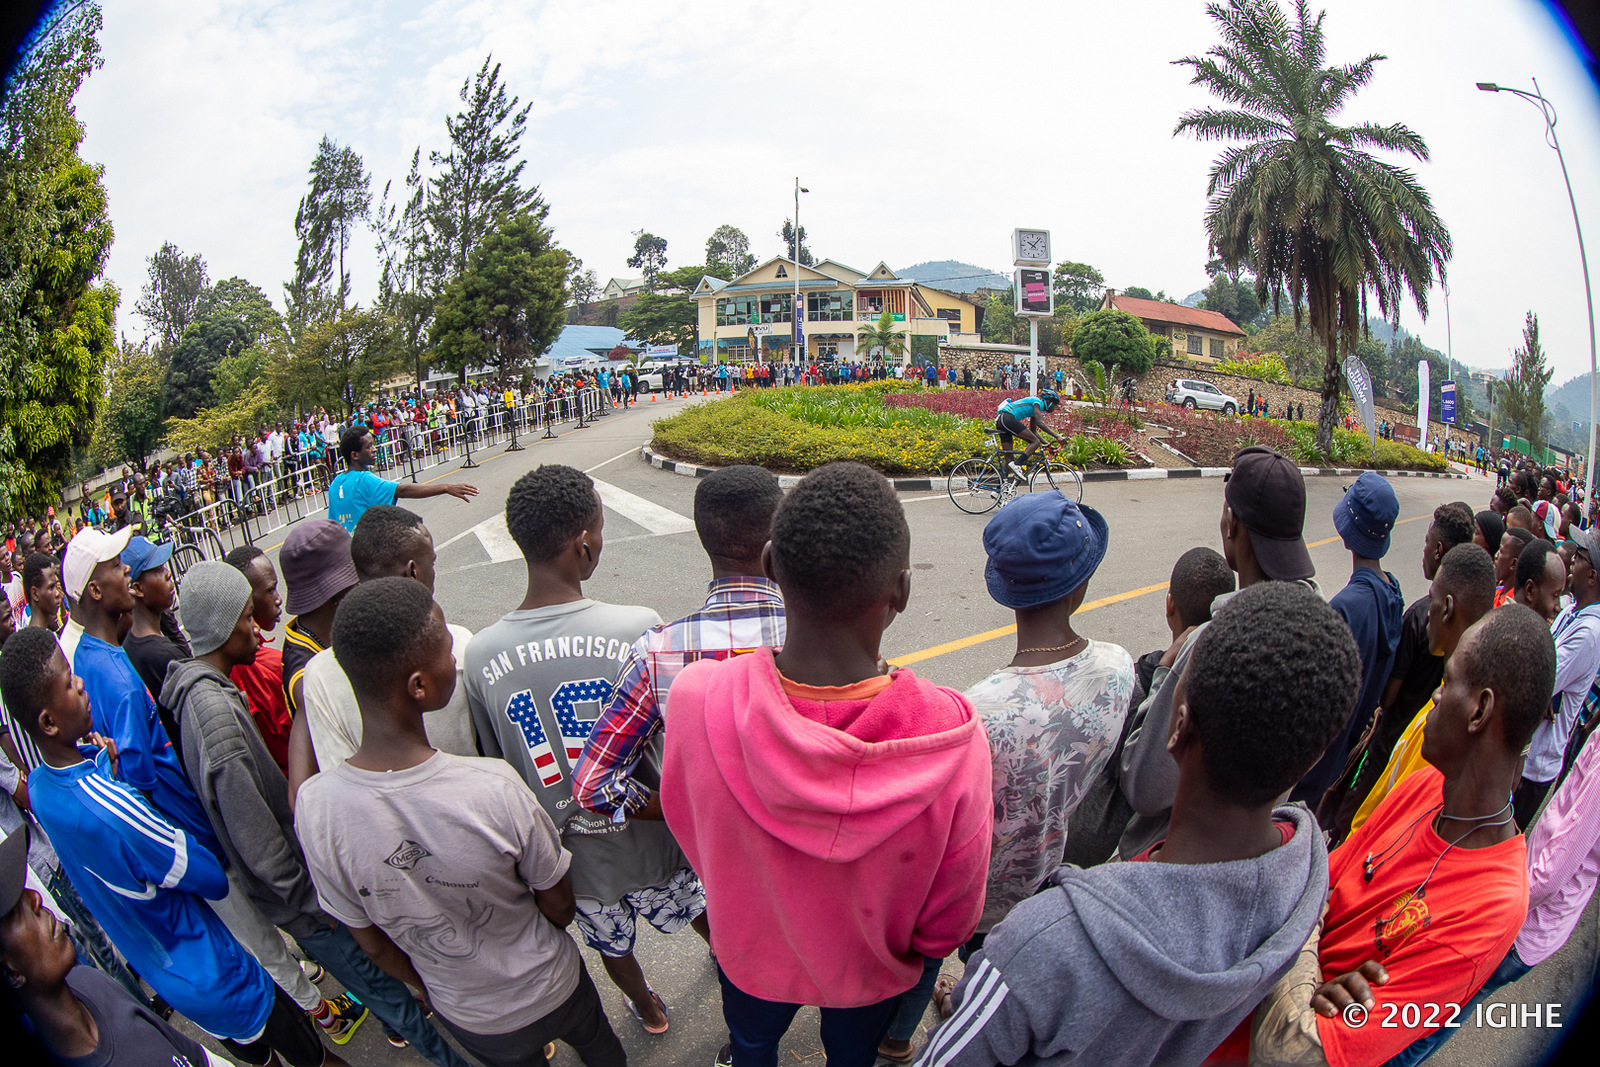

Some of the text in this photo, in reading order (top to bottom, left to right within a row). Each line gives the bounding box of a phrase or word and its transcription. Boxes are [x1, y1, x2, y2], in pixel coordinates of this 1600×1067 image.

[482, 636, 631, 686] SAN FRANCISCO
[568, 815, 605, 828] MARATHON
[570, 822, 608, 834] SEPTEMBER
[396, 847, 420, 865] MBS
